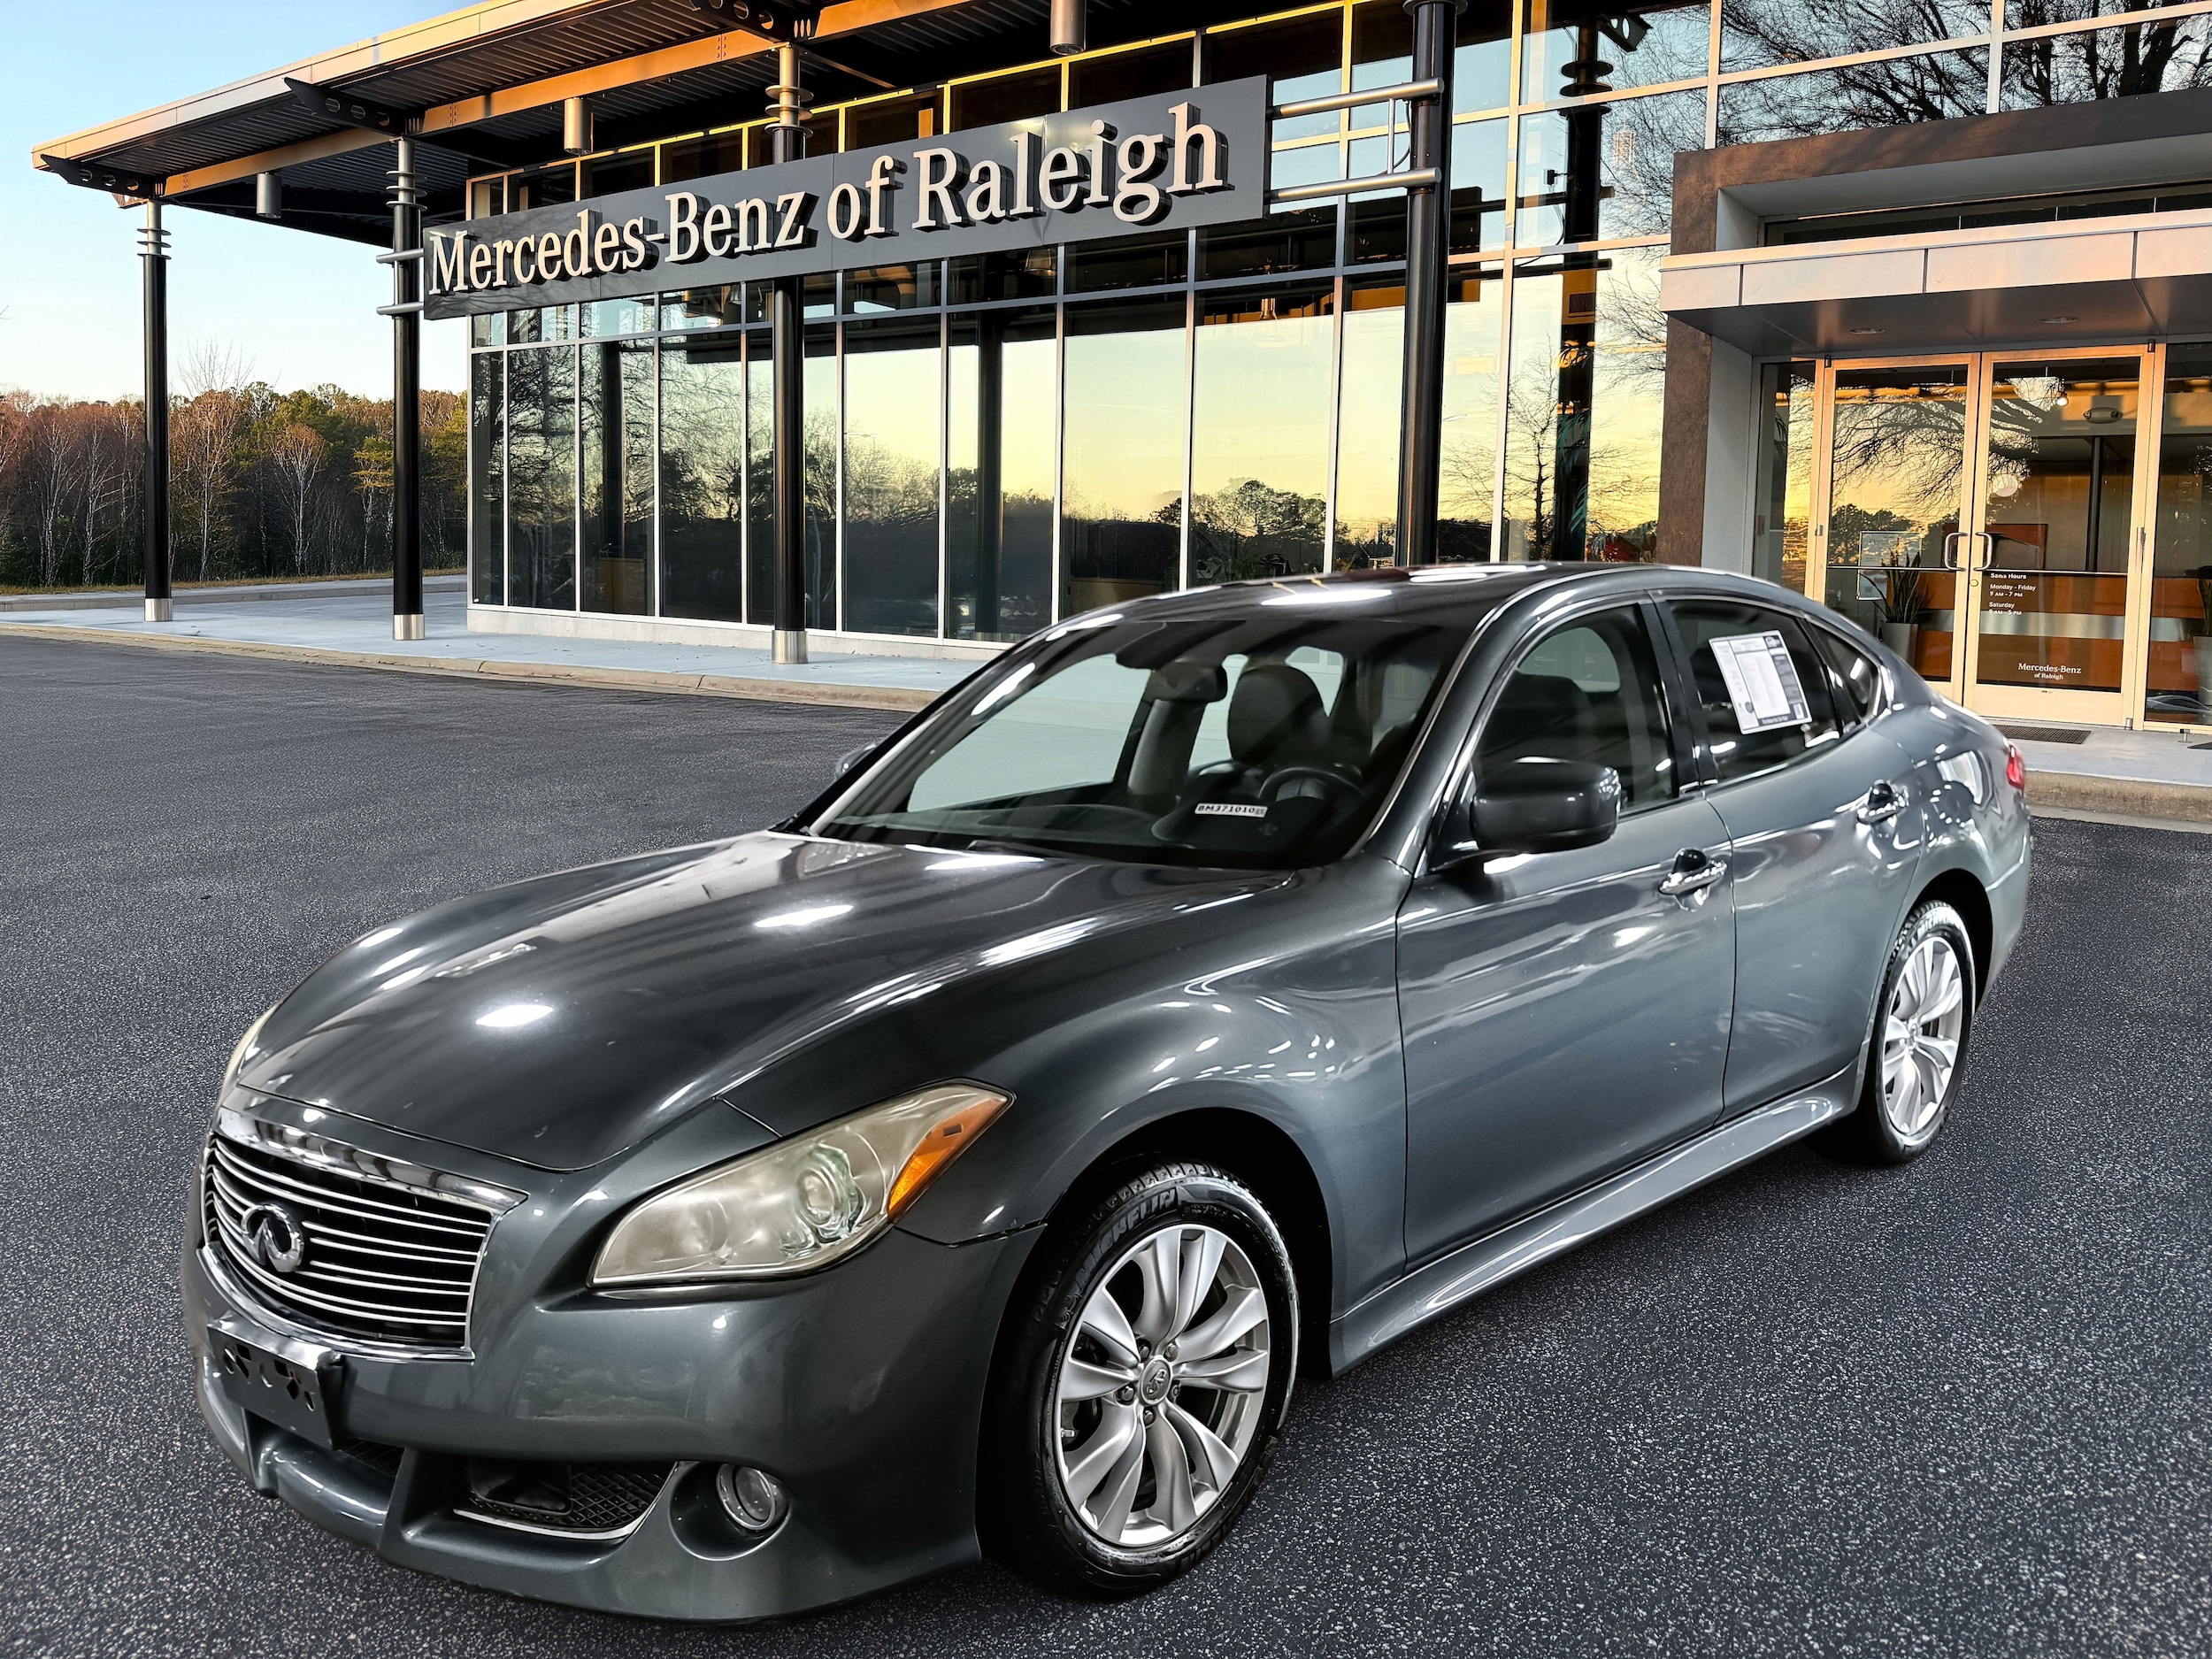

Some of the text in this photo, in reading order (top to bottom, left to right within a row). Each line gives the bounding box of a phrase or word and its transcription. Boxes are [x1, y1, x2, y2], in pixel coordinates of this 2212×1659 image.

[429, 101, 1222, 296] Mercedes-Benz of Raleigh
[2018, 663, 2081, 673] Mercedes-Benz
